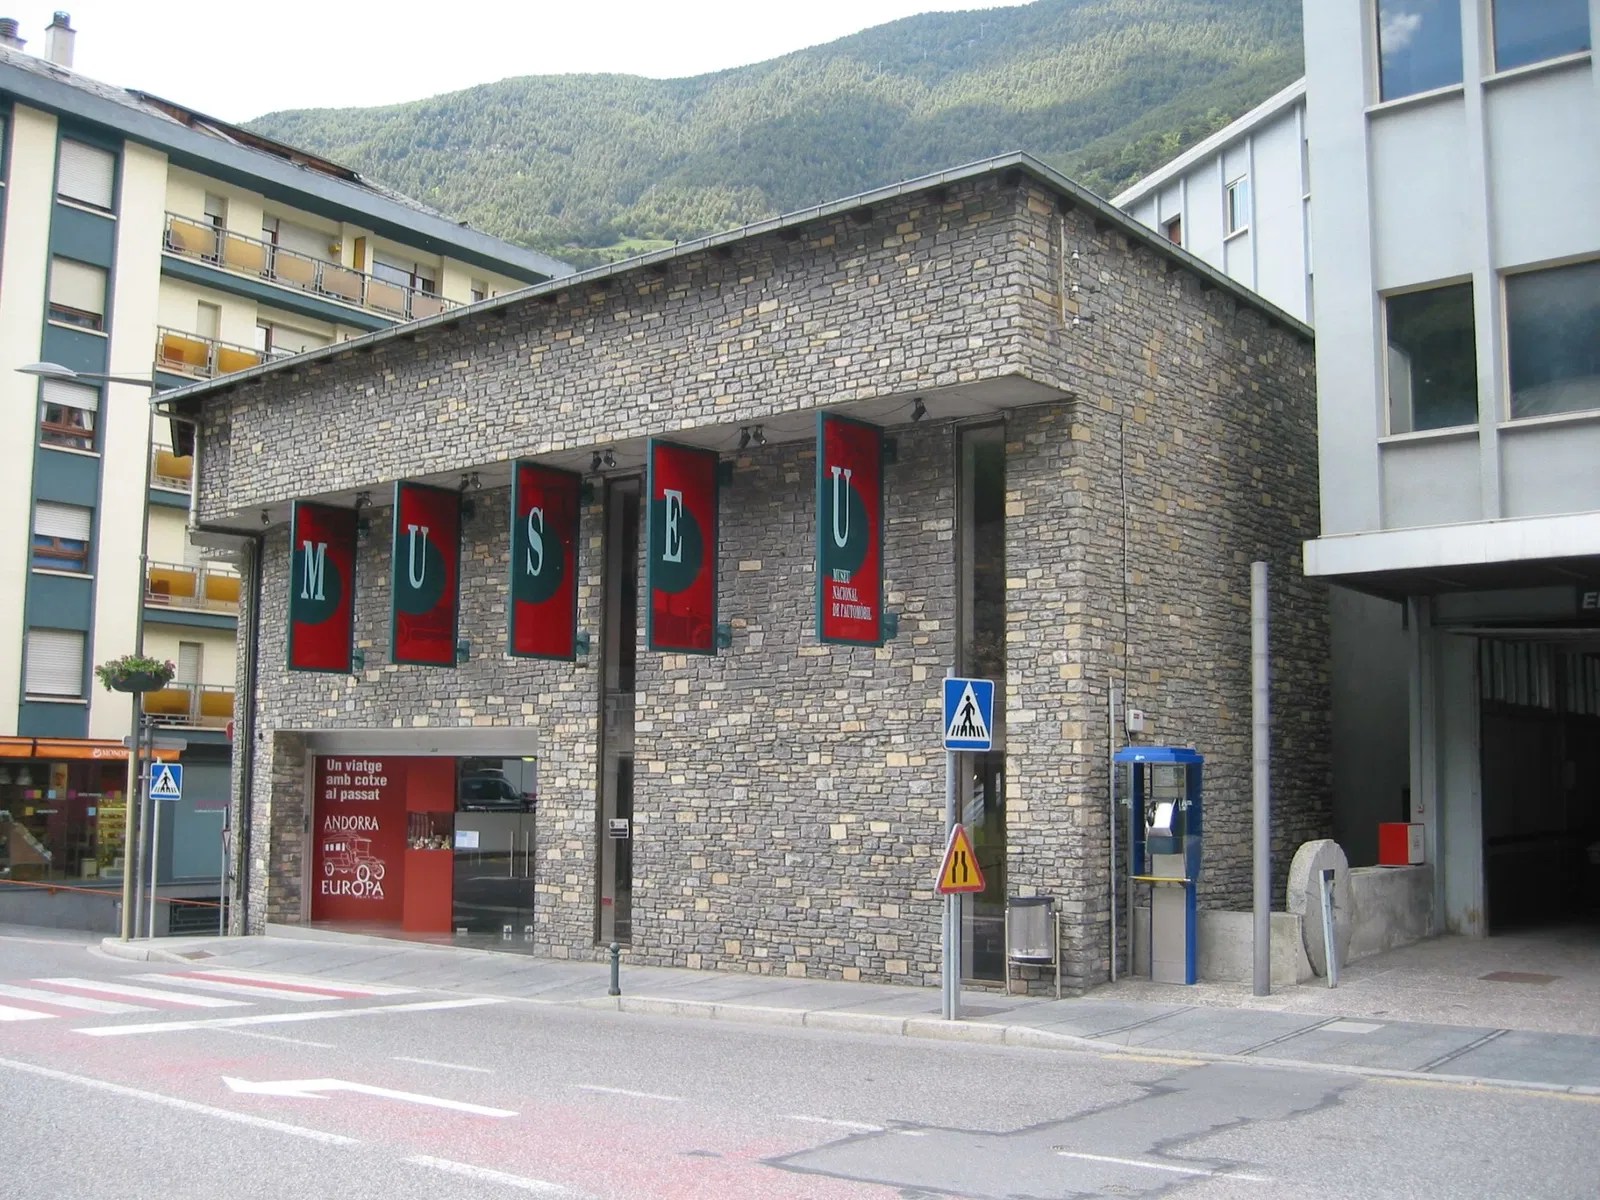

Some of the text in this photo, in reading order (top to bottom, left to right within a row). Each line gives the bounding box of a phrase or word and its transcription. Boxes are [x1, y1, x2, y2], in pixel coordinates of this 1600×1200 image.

[831, 465, 852, 548] U
[662, 488, 683, 563] E
[526, 506, 544, 577] S
[407, 523, 429, 589] U
[300, 540, 328, 601] M
[832, 568, 851, 584] MUSEU
[832, 585, 858, 602] NACIONAL
[326, 759, 383, 774] Un viatge
[326, 773, 388, 787] amb cotxe
[325, 787, 380, 802] al passat
[324, 815, 379, 830] ANDORRA
[321, 879, 384, 896] EUROPA
